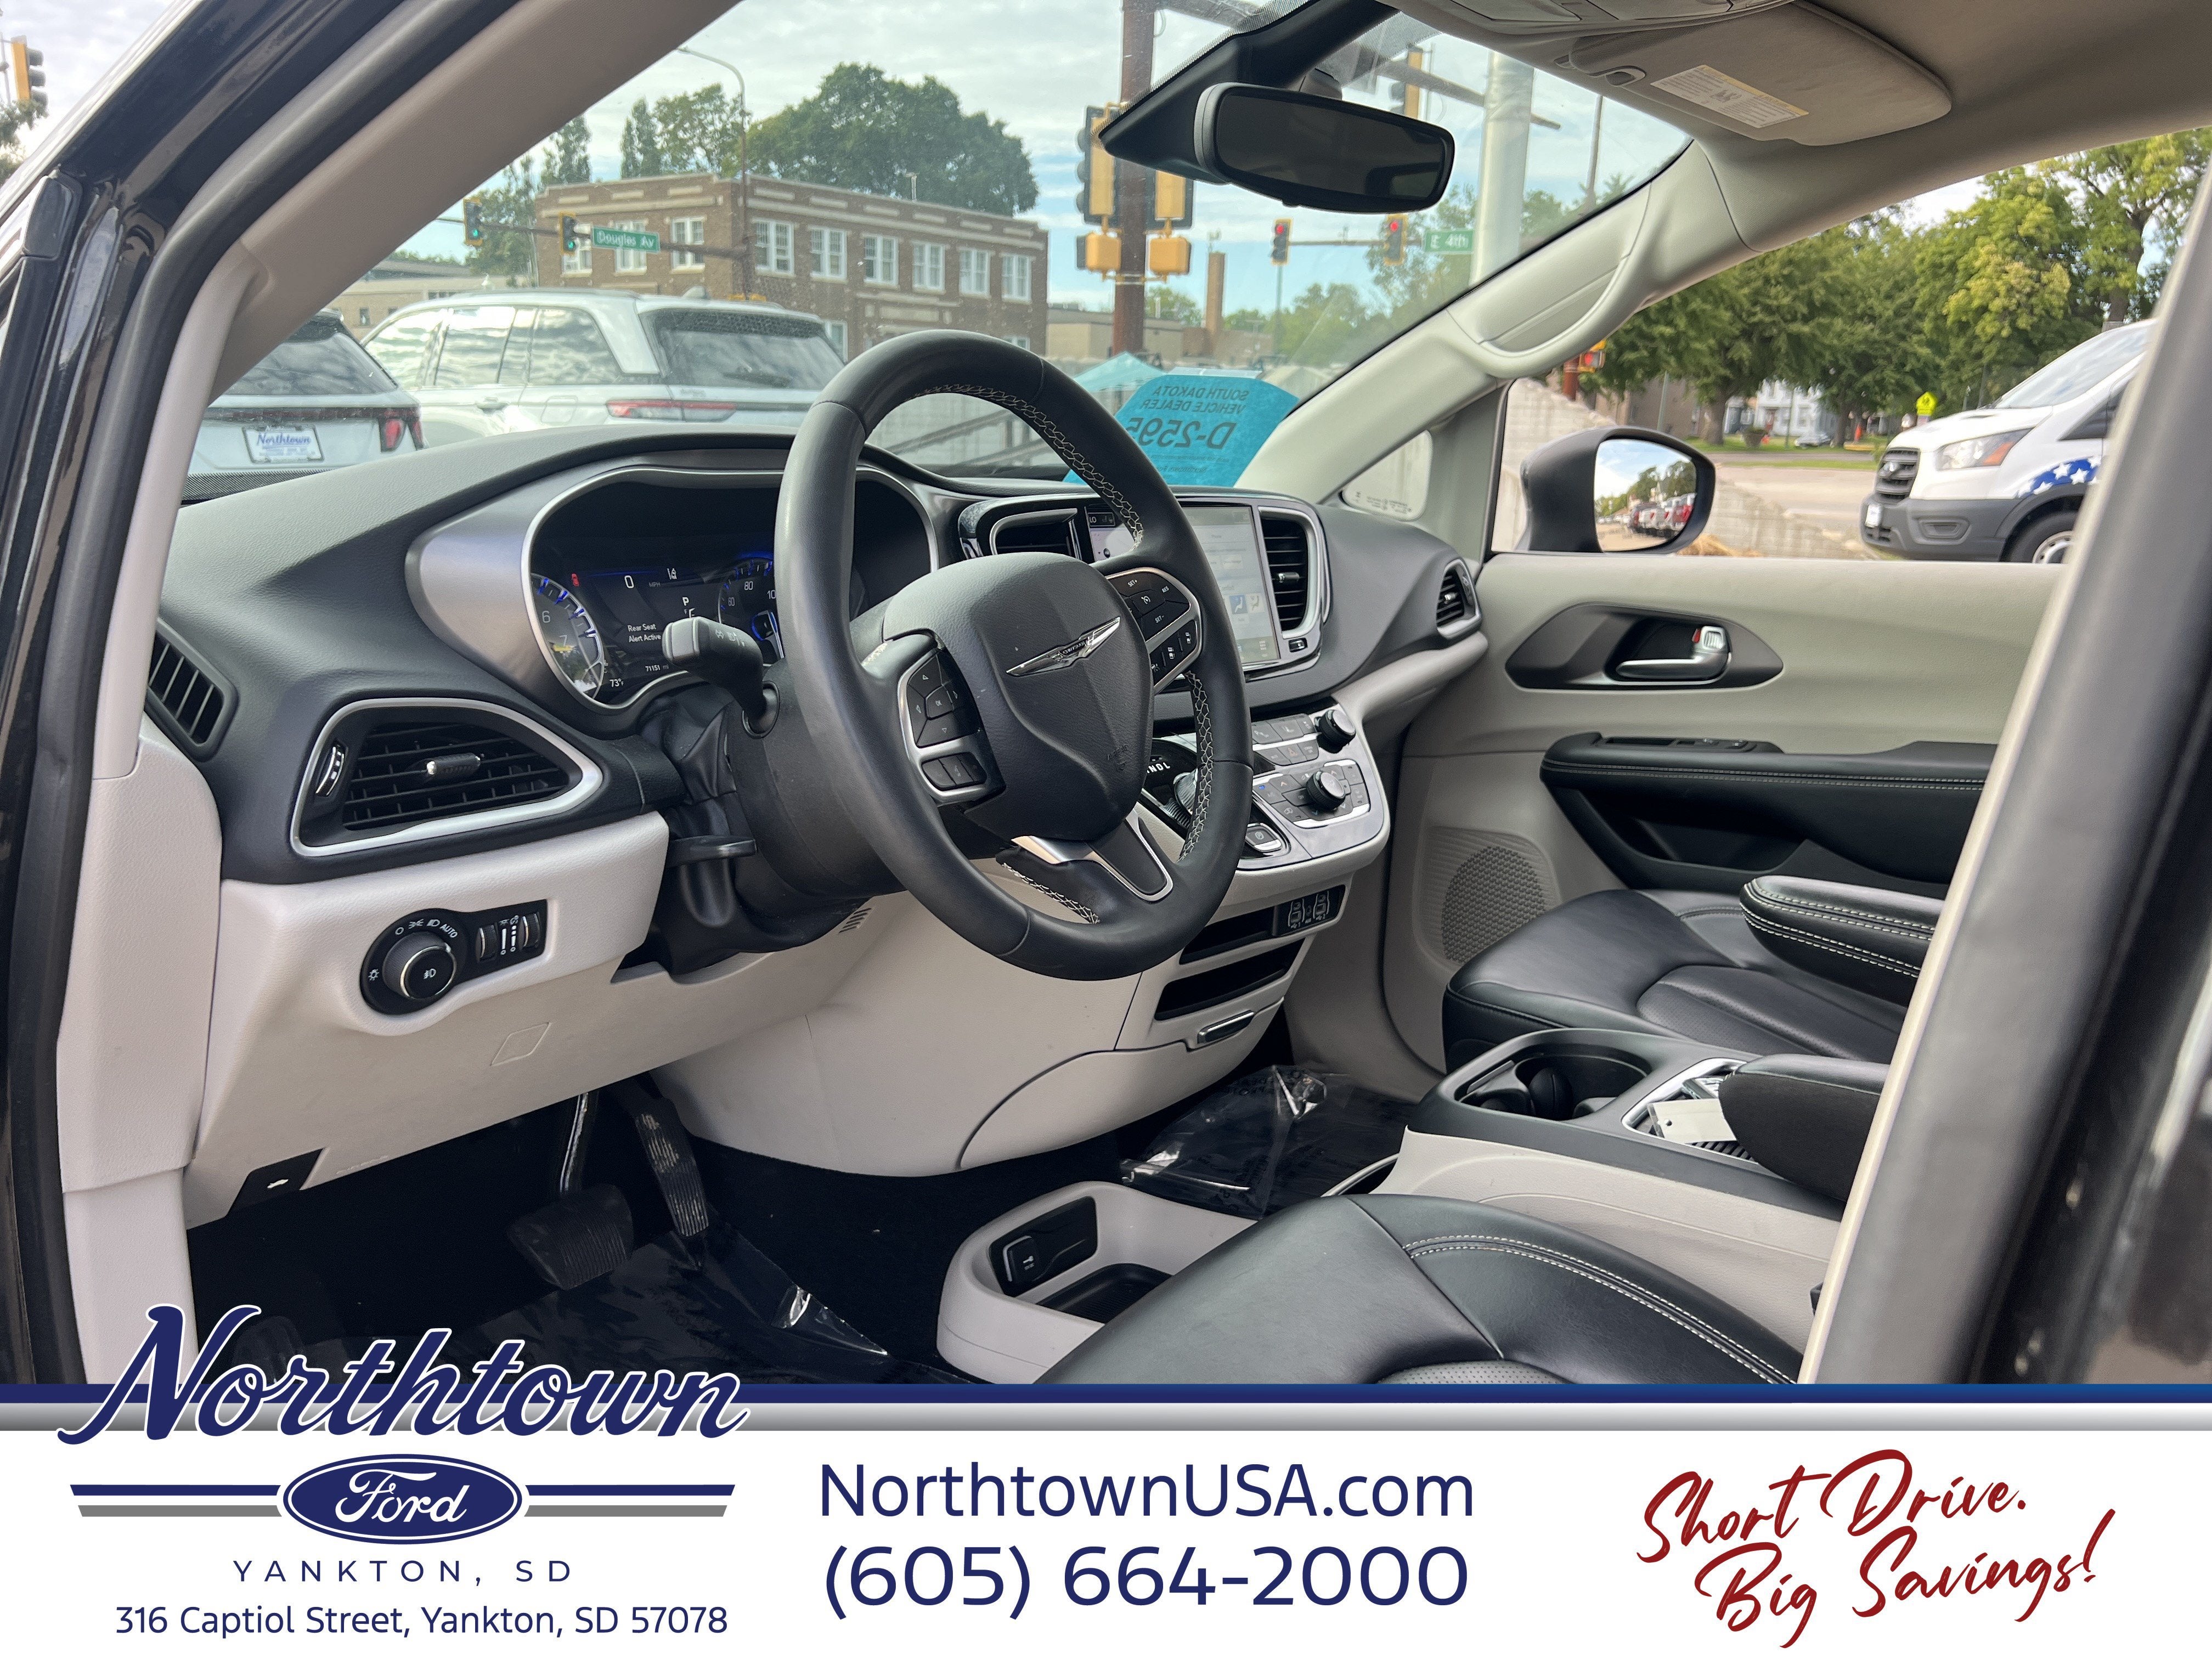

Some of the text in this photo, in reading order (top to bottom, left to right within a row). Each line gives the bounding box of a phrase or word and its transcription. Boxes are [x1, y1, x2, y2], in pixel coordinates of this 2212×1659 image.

[596, 230, 654, 248] Douglas Av
[1430, 234, 1469, 249] E 4th
[256, 432, 311, 447] Northtown
[624, 575, 634, 589] 0
[744, 580, 753, 590] 80
[767, 589, 776, 600] 10
[682, 596, 689, 606] P
[541, 610, 551, 623] 6
[559, 634, 567, 646] 7
[629, 633, 661, 643] Alert Active
[1147, 762, 1171, 774] NDL
[439, 923, 458, 938] AUTO
